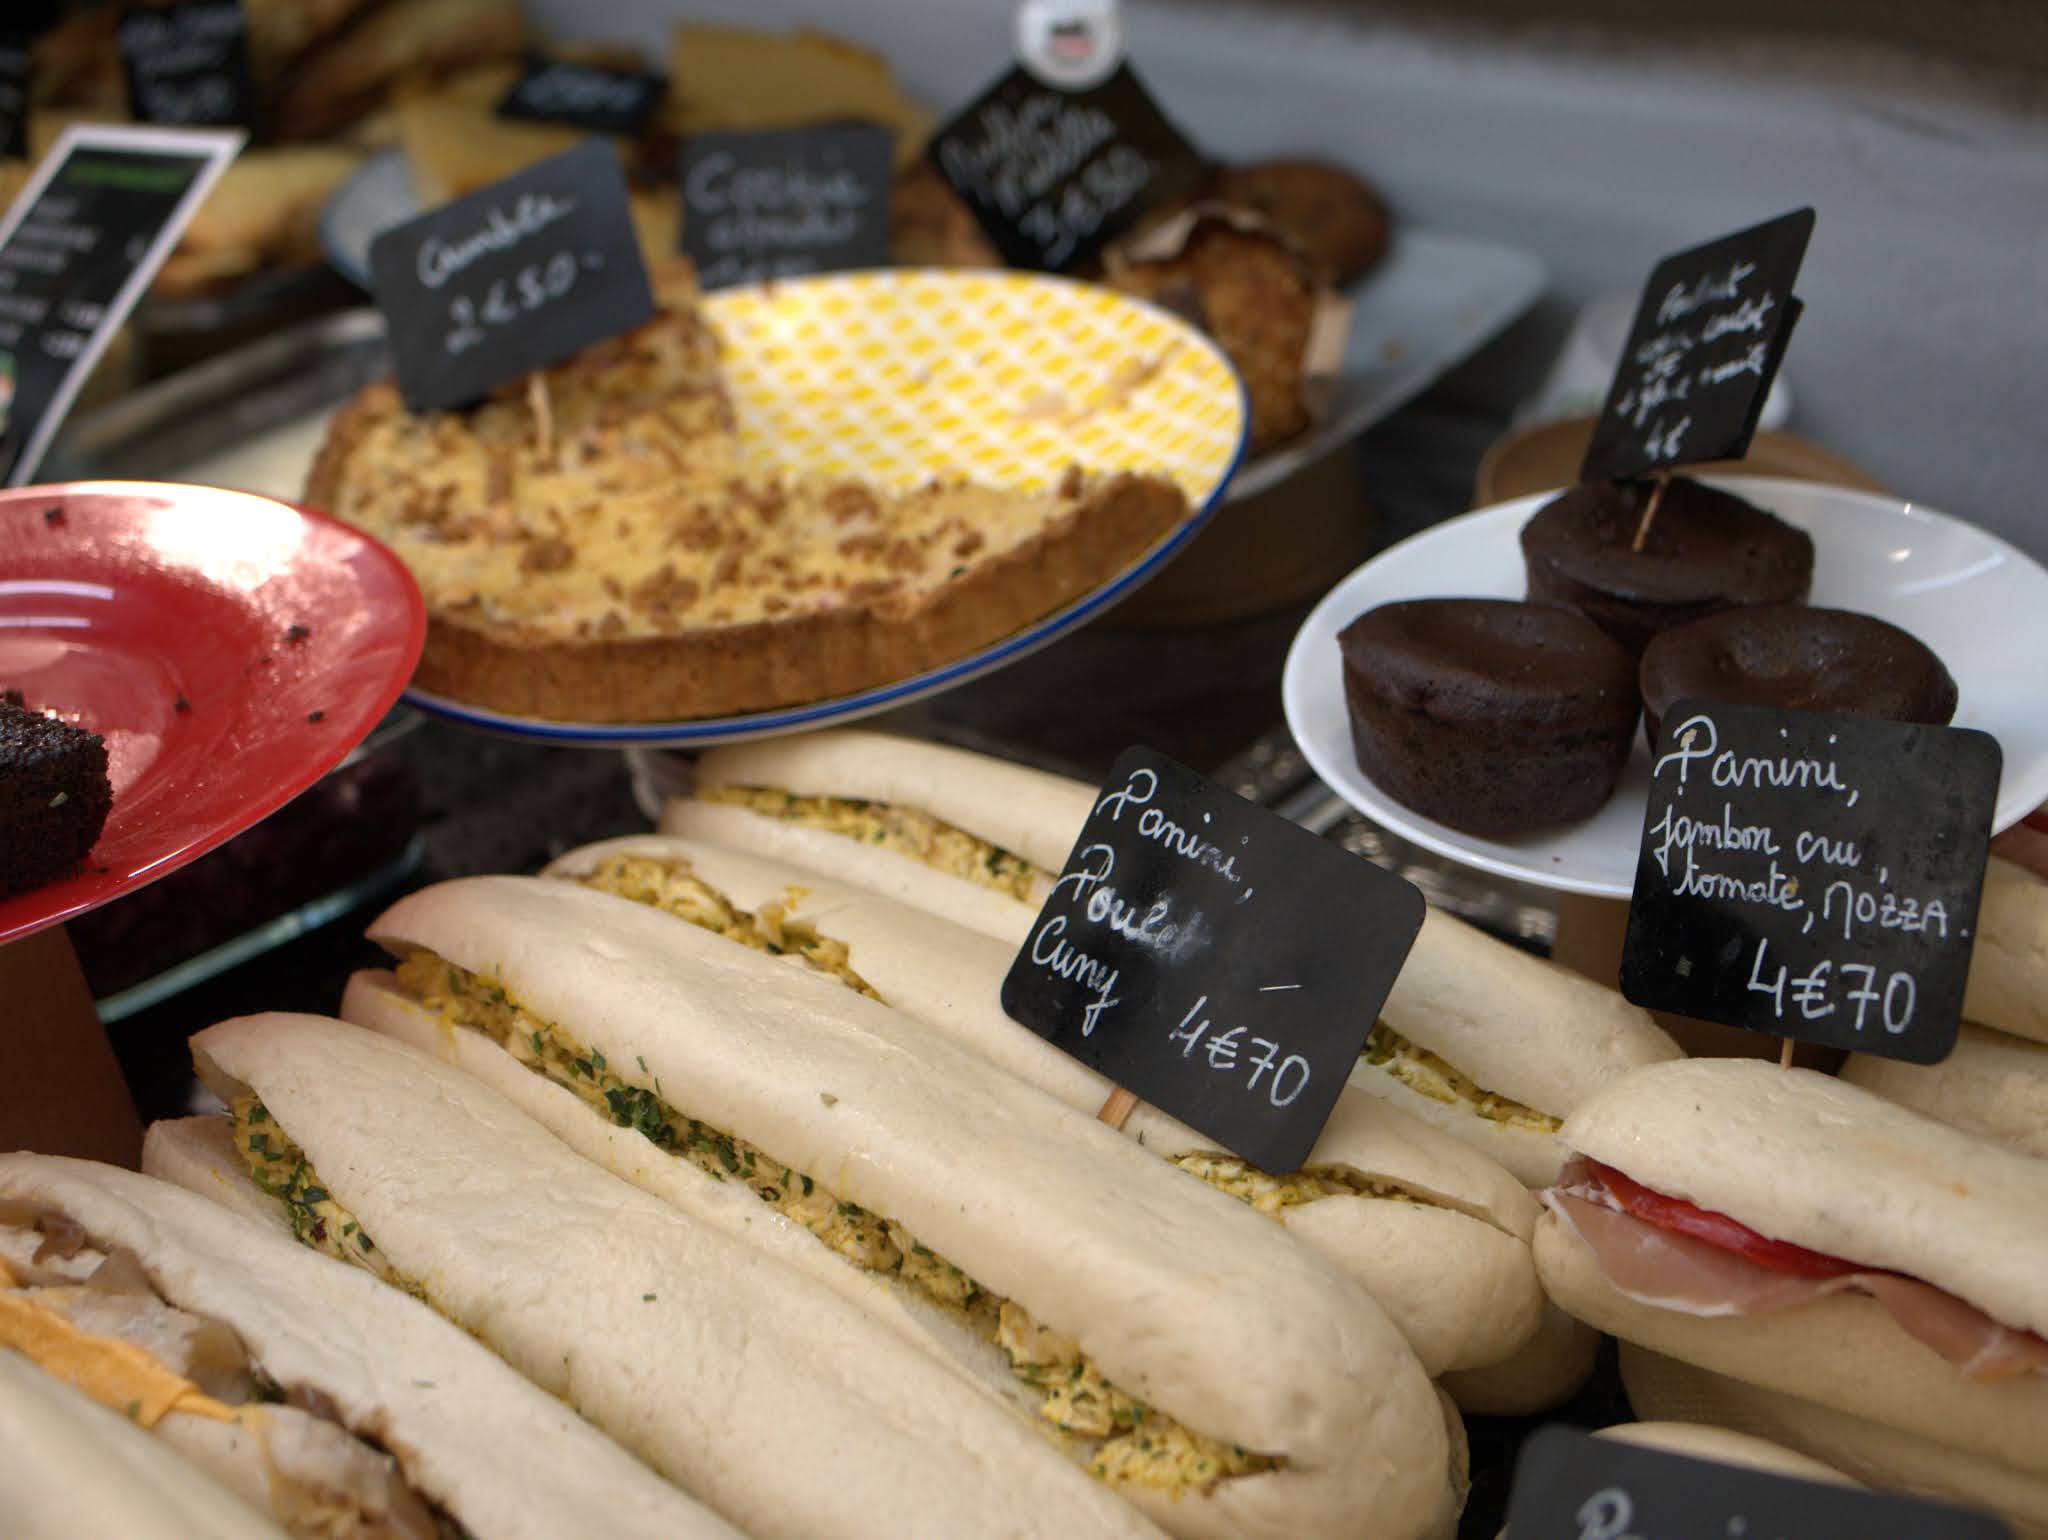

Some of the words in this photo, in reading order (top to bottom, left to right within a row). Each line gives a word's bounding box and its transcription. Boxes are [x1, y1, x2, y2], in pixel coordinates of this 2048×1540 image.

[1653, 715, 1859, 807] Panini,
[1096, 769, 1253, 903] Panini,
[1673, 858, 1813, 934] tomate,
[1747, 937, 1916, 1035] 4€70
[1169, 996, 1310, 1107] 4€70
